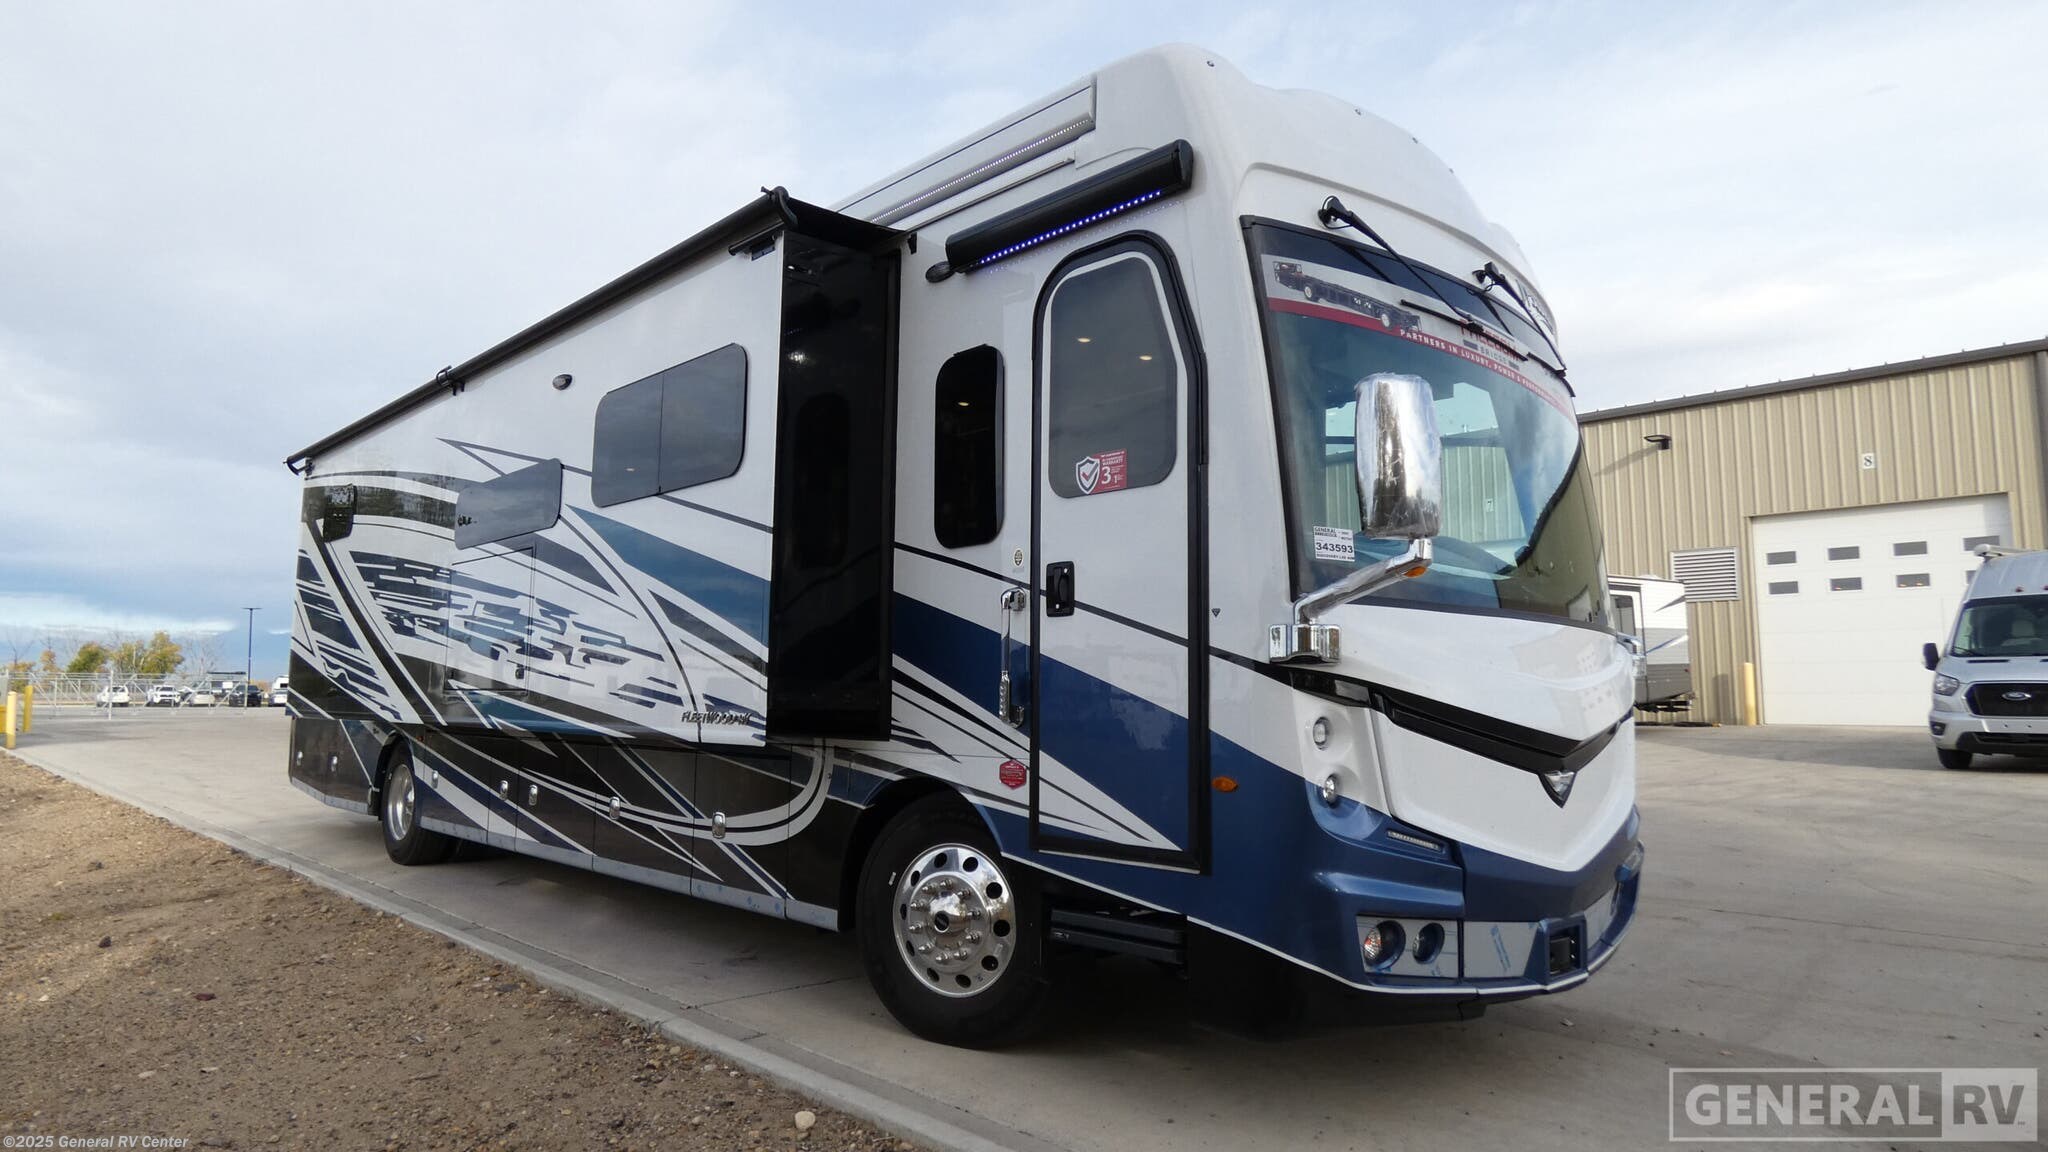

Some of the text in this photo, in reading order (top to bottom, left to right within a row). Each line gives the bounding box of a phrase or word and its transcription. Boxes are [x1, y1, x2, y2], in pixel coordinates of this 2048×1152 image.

[1400, 329, 1446, 350] PARTNERS
[1449, 345, 1458, 355] IN
[1101, 466, 1112, 485] 3
[1316, 542, 1353, 554] 343593
